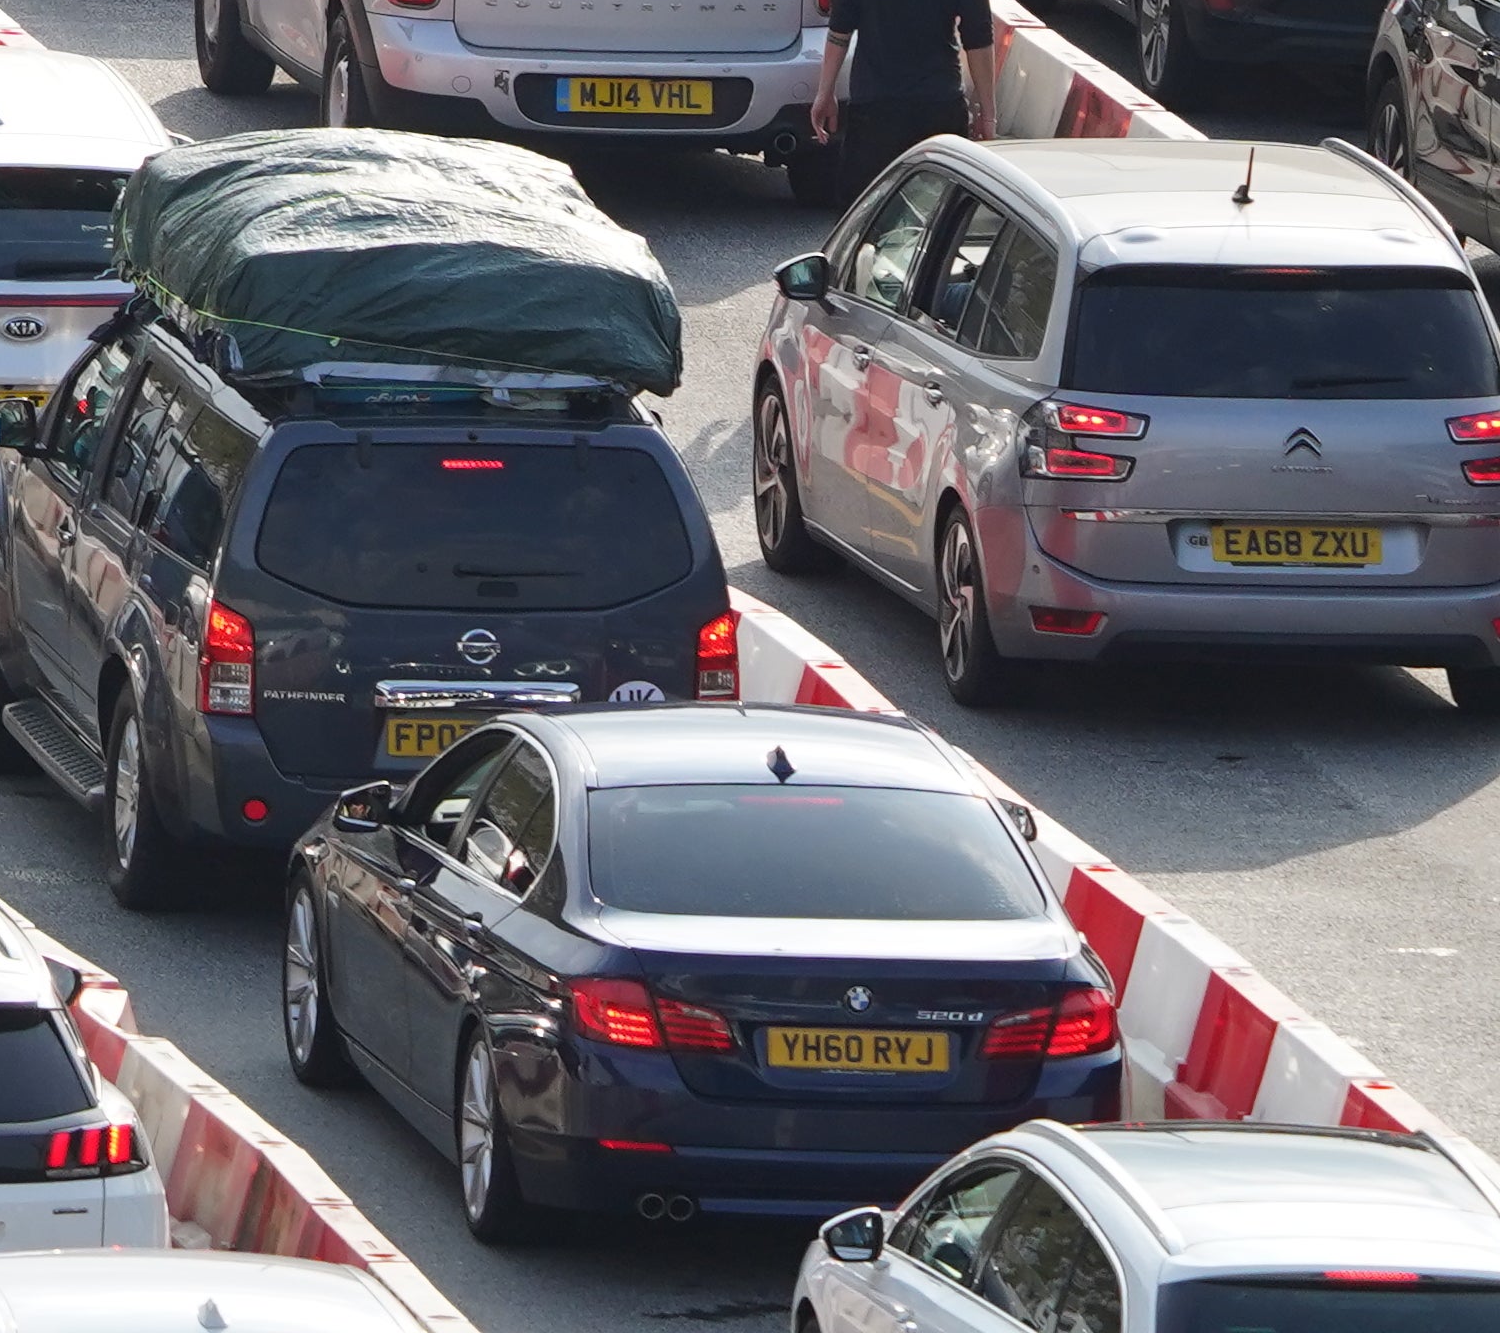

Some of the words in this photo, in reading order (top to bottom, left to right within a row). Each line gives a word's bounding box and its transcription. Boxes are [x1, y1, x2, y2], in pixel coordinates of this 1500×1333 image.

[485, 0, 778, 13] COUNTRYMAN
[580, 83, 640, 108] MJ14
[649, 84, 703, 109] VHL
[10, 322, 38, 335] KIA
[1187, 536, 1208, 547] GB
[1223, 528, 1302, 556] EA68
[1312, 530, 1370, 558] ZXU
[263, 689, 345, 703] PATHFINDER
[782, 1034, 863, 1063] YH60
[874, 1036, 934, 1065] RYJ
